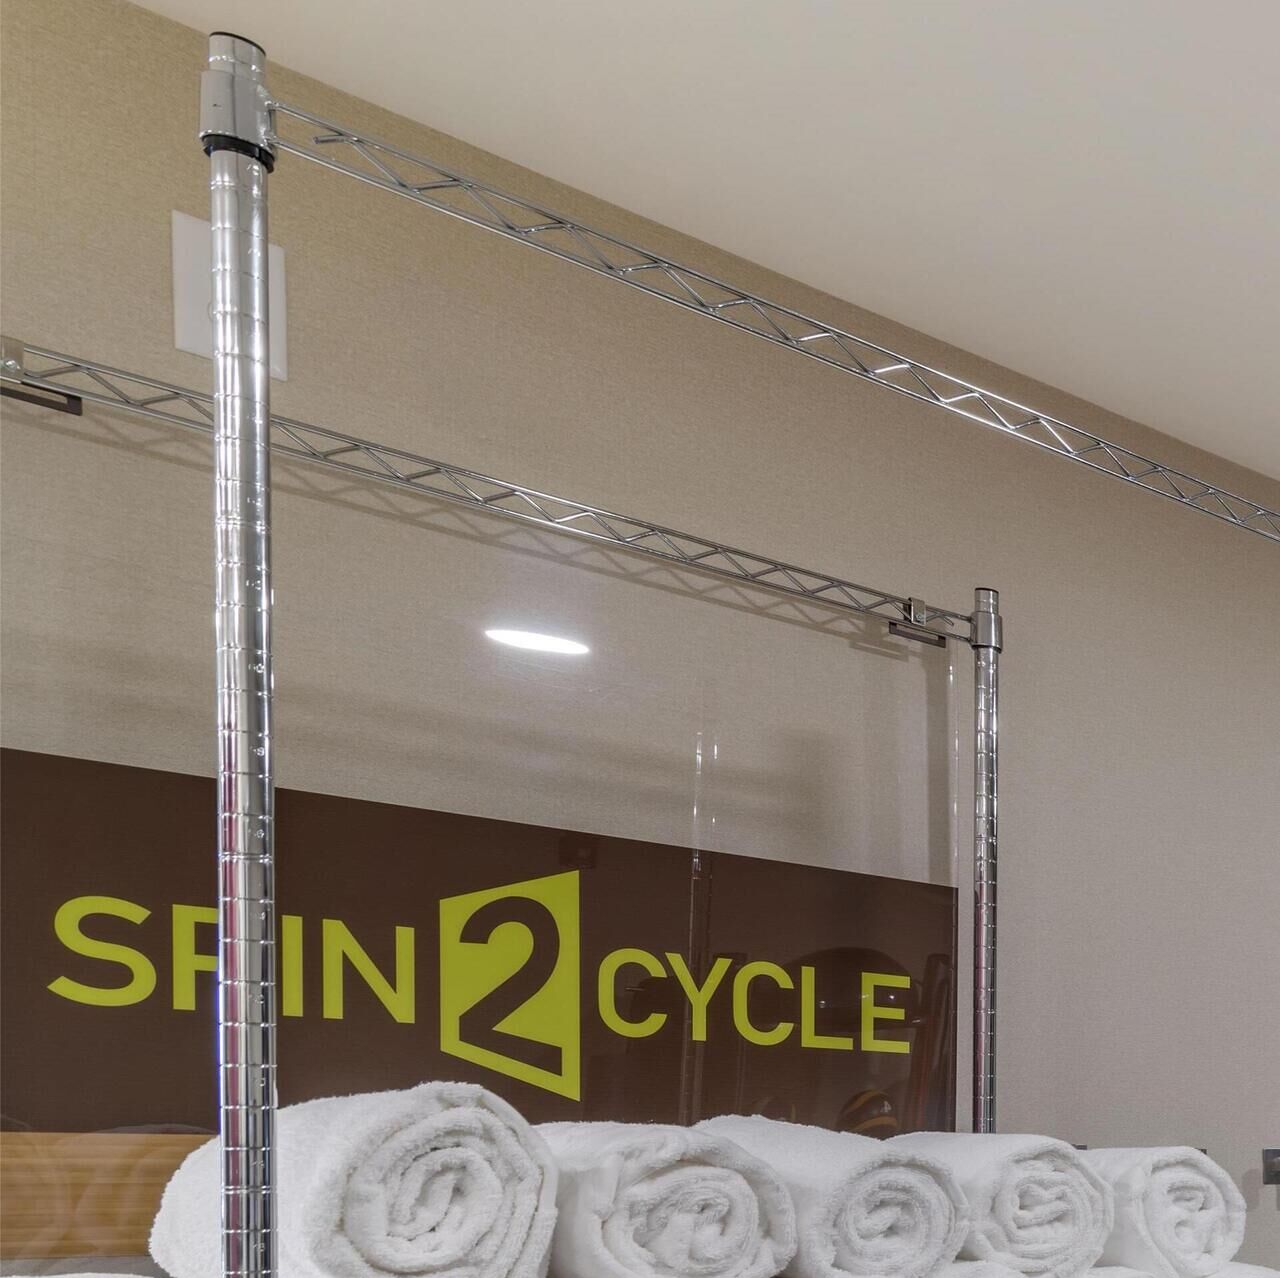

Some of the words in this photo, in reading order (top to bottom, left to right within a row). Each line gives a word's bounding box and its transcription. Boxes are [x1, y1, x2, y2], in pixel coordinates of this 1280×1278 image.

[47, 896, 415, 1023] SPIN
[457, 894, 563, 1077] 2
[597, 947, 912, 1054] CYCLE
